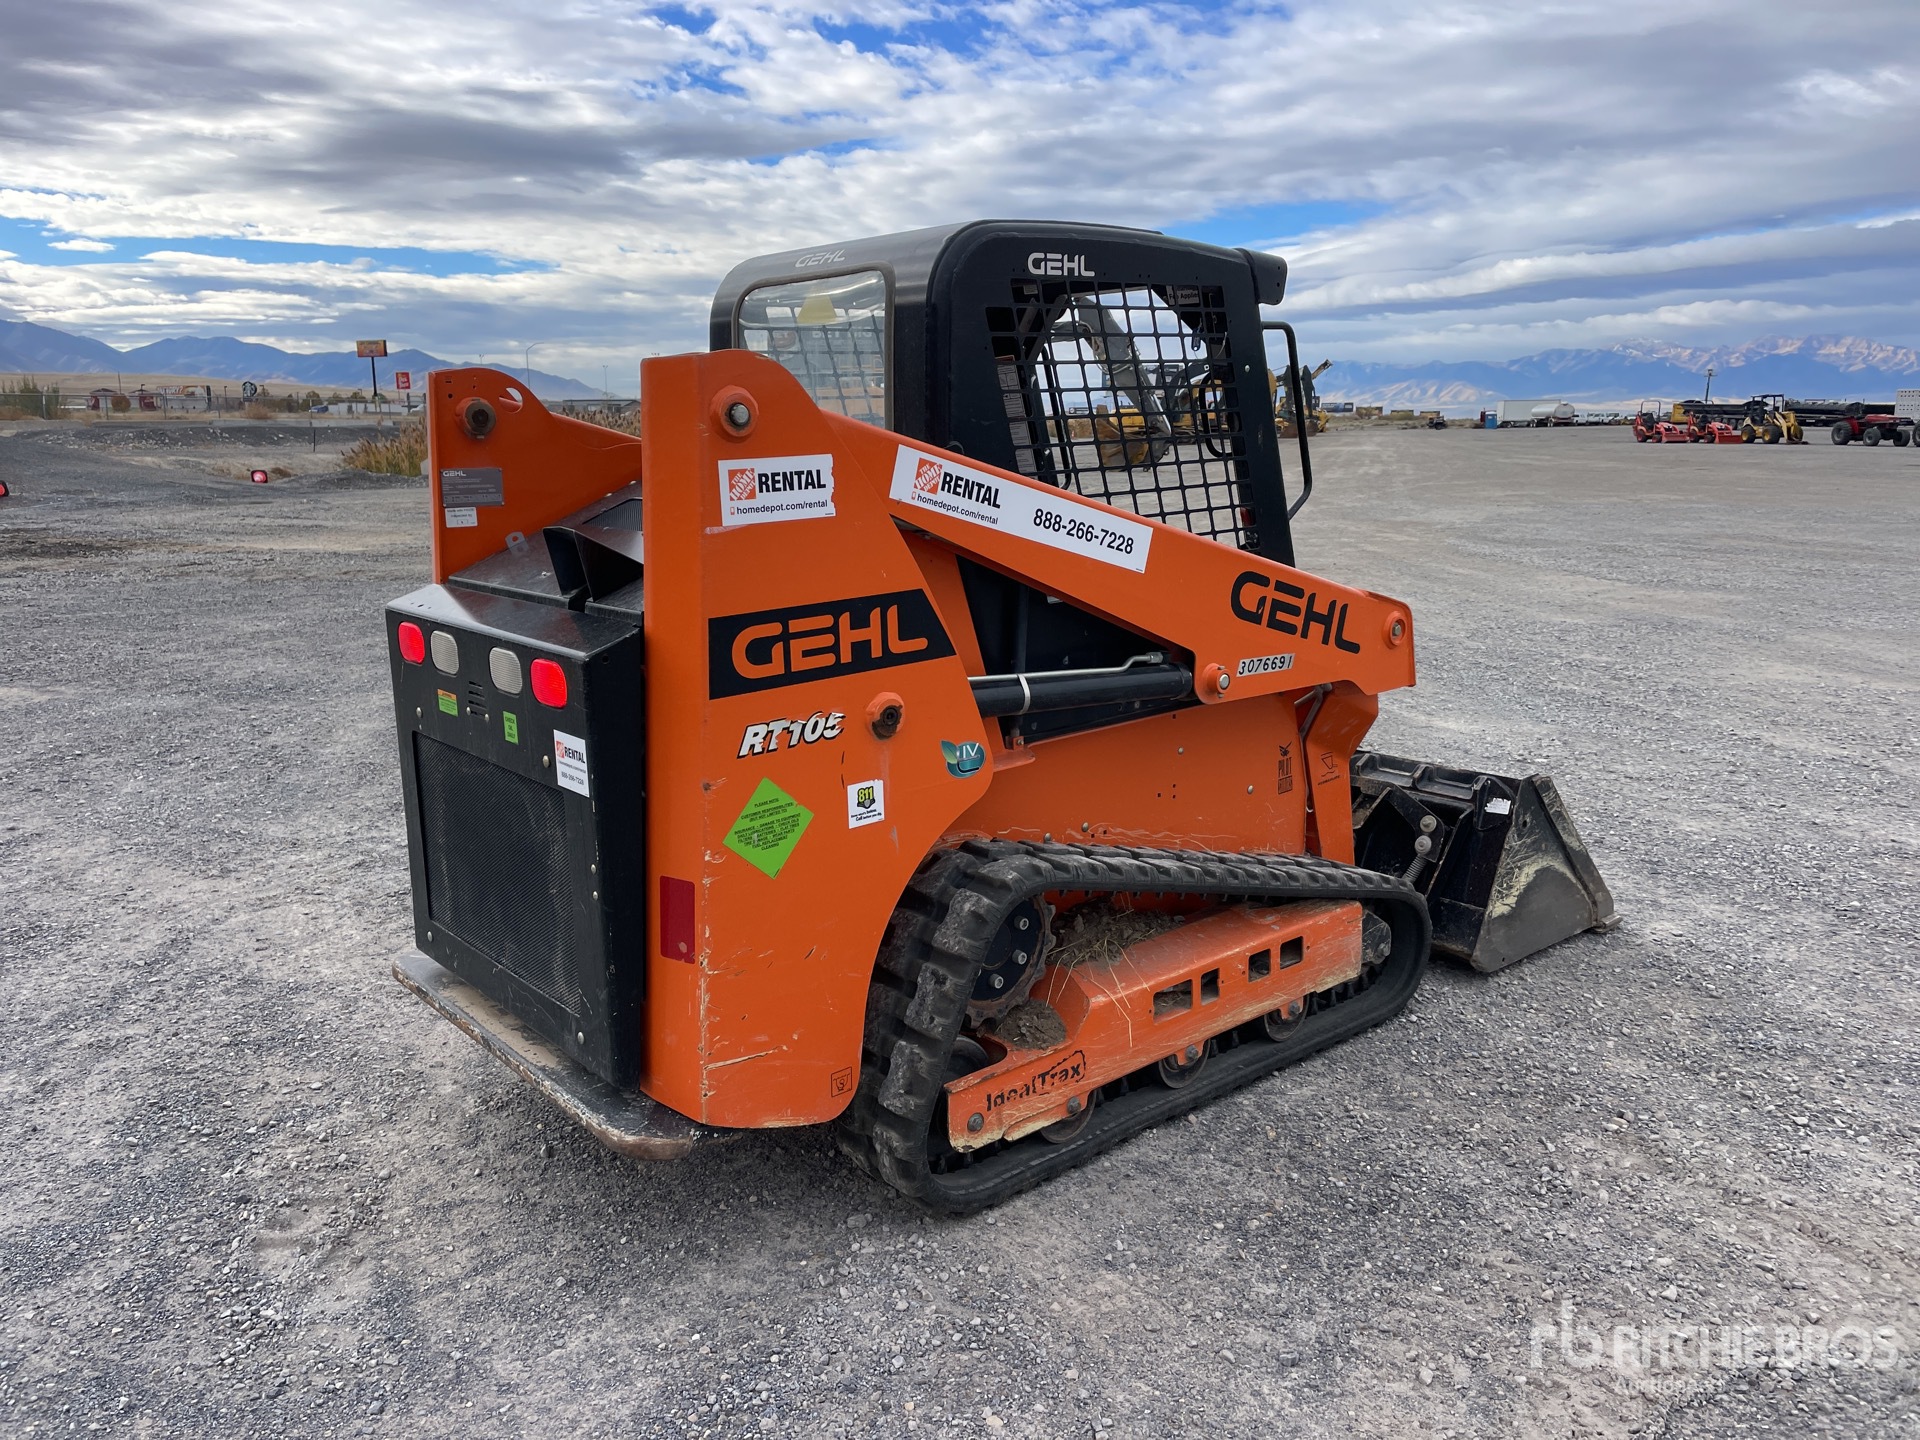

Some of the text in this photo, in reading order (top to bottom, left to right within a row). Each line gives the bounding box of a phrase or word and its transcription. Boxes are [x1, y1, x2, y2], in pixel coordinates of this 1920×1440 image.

[795, 249, 846, 268] GEHL
[1028, 252, 1095, 276] GEHL
[920, 463, 930, 474] THE
[730, 468, 826, 500] HOME RENTAL
[732, 472, 742, 486] THE
[914, 462, 1000, 509] HOME RENTAL
[924, 477, 940, 492] DEPOT
[740, 481, 756, 500] DEPOT
[736, 500, 828, 514] homedepot.com/rental
[916, 493, 998, 525] homedepot.com/rental
[1034, 508, 1134, 554] 888-266-7228
[1230, 571, 1360, 654] GEHL
[732, 604, 928, 680] GEHL
[1238, 655, 1293, 676] 3076691
[564, 746, 586, 764] RENTAL
[858, 786, 874, 803] 811
[741, 811, 761, 819] CUSTOMER
[986, 1061, 1082, 1112] IdealTrax
